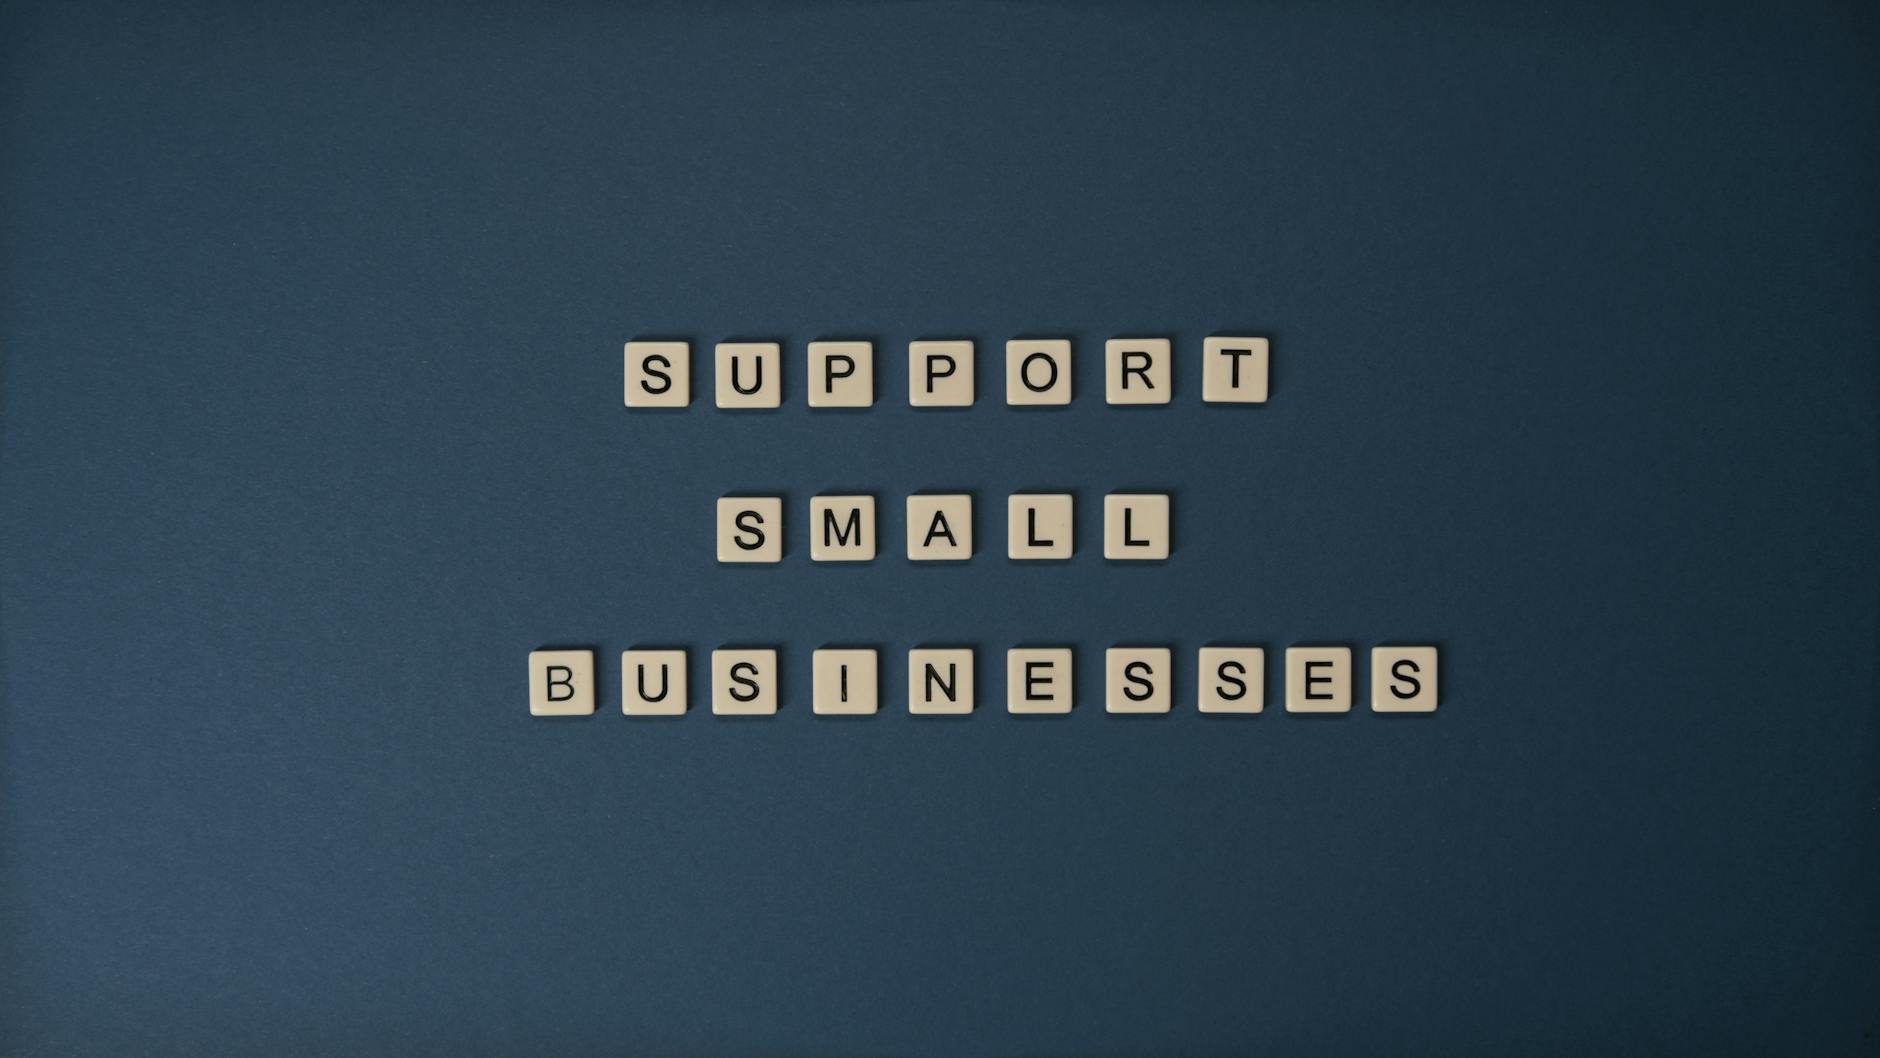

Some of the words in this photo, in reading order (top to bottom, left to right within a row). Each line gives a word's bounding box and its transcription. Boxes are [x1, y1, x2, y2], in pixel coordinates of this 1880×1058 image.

[640, 348, 1253, 396] SUPPORT
[732, 507, 1151, 551] SMALL
[545, 659, 1422, 703] BUSINESSES
